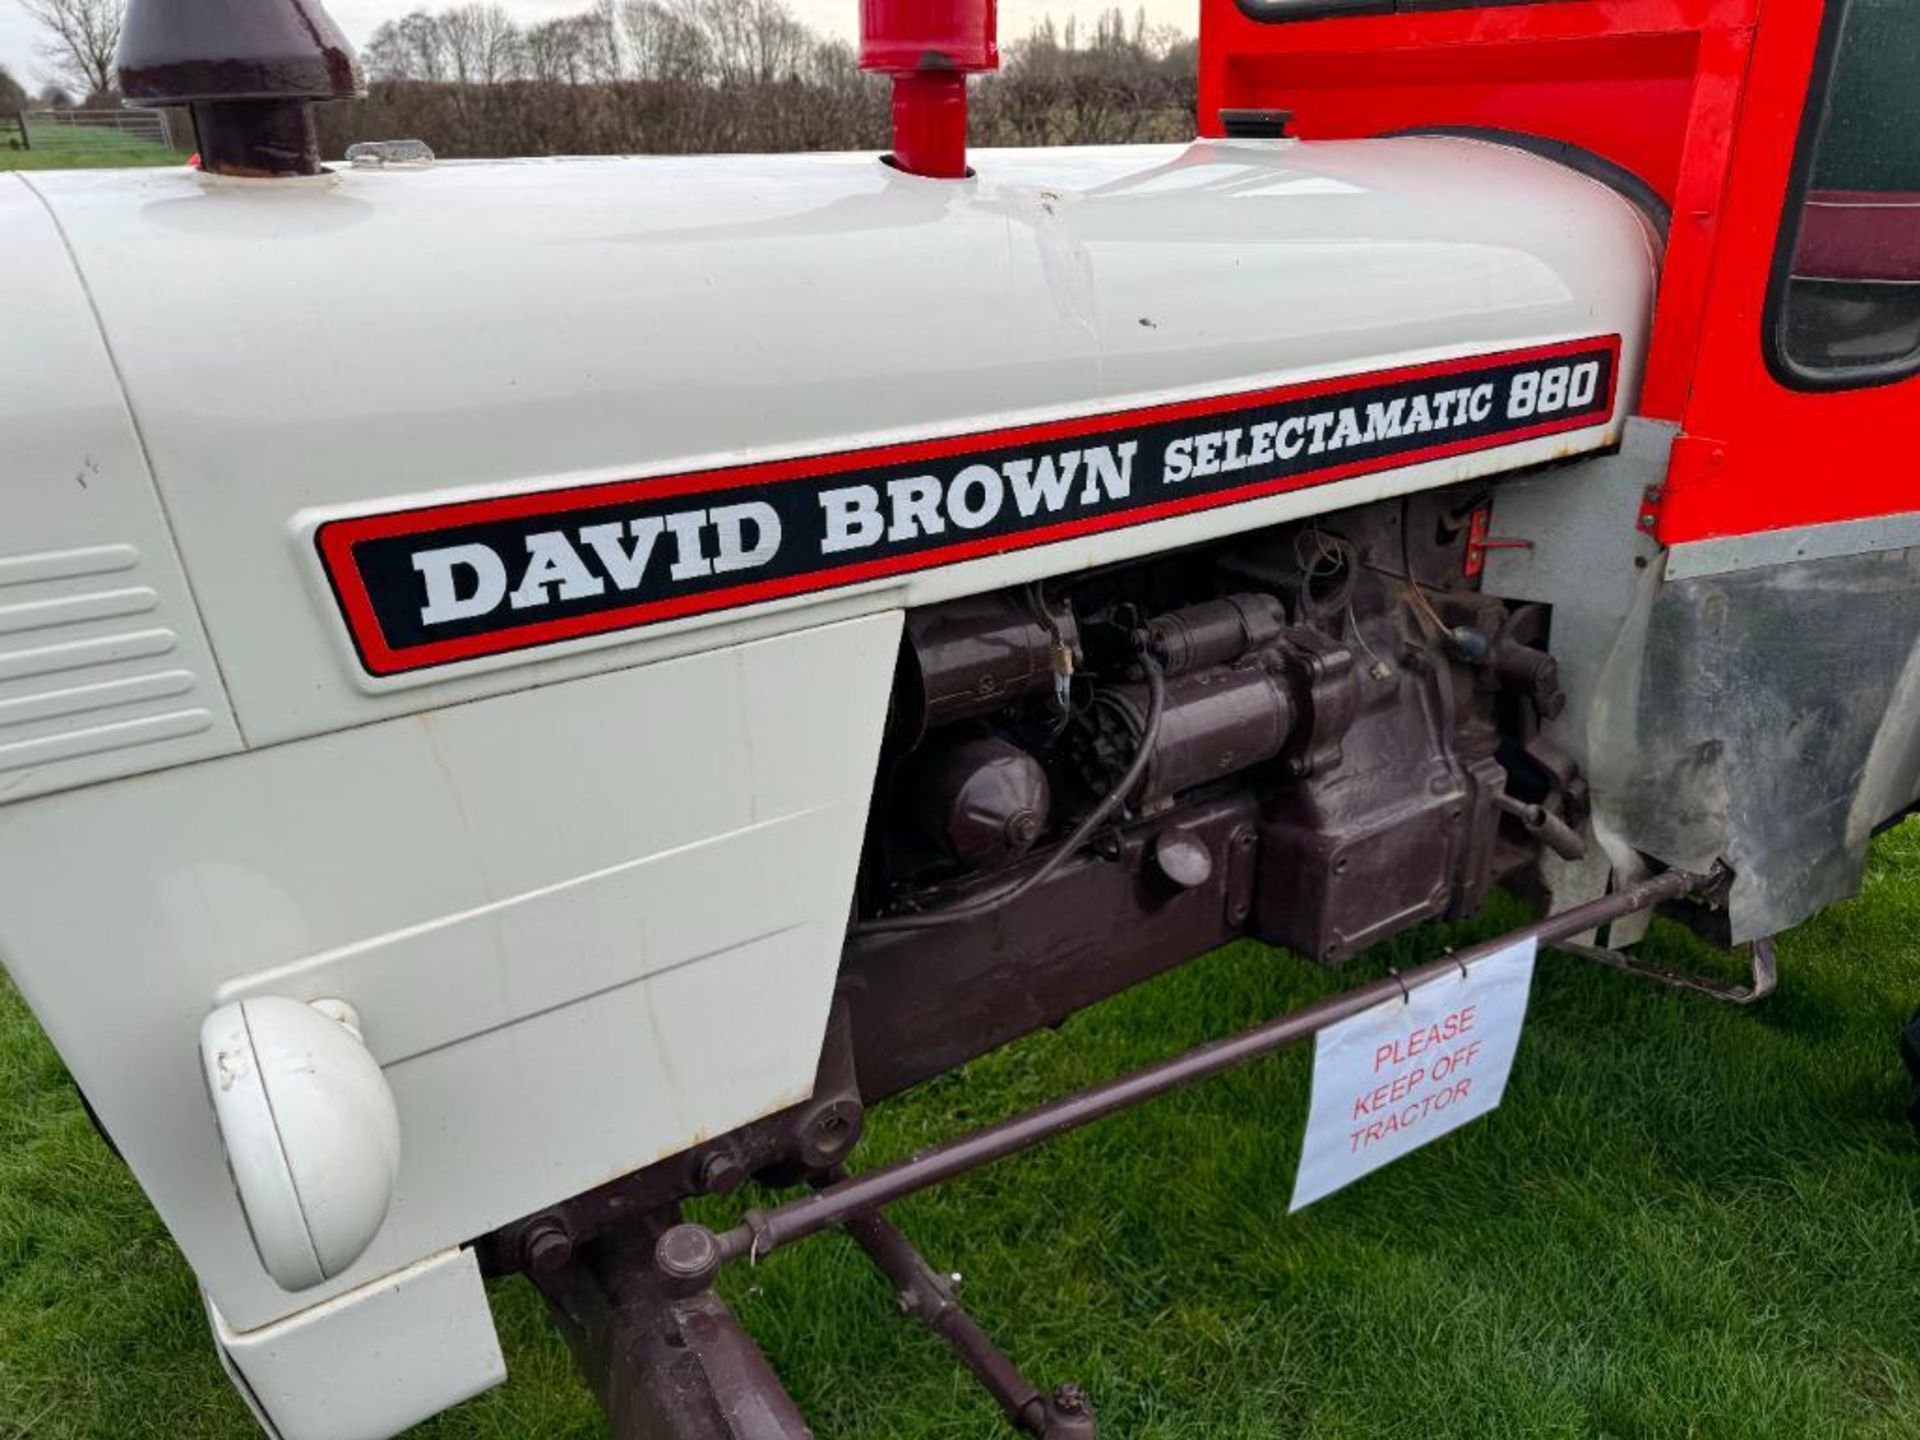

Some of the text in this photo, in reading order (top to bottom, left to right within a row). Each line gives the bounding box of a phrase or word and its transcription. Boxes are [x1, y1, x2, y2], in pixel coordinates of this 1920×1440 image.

[412, 360, 1599, 627] DAVID BROWN SELECTAMATIC 880
[1375, 1006, 1475, 1071] PLEASE
[1351, 1079, 1471, 1152] TRACTOR
[1353, 1042, 1481, 1120] KEEP OFF
